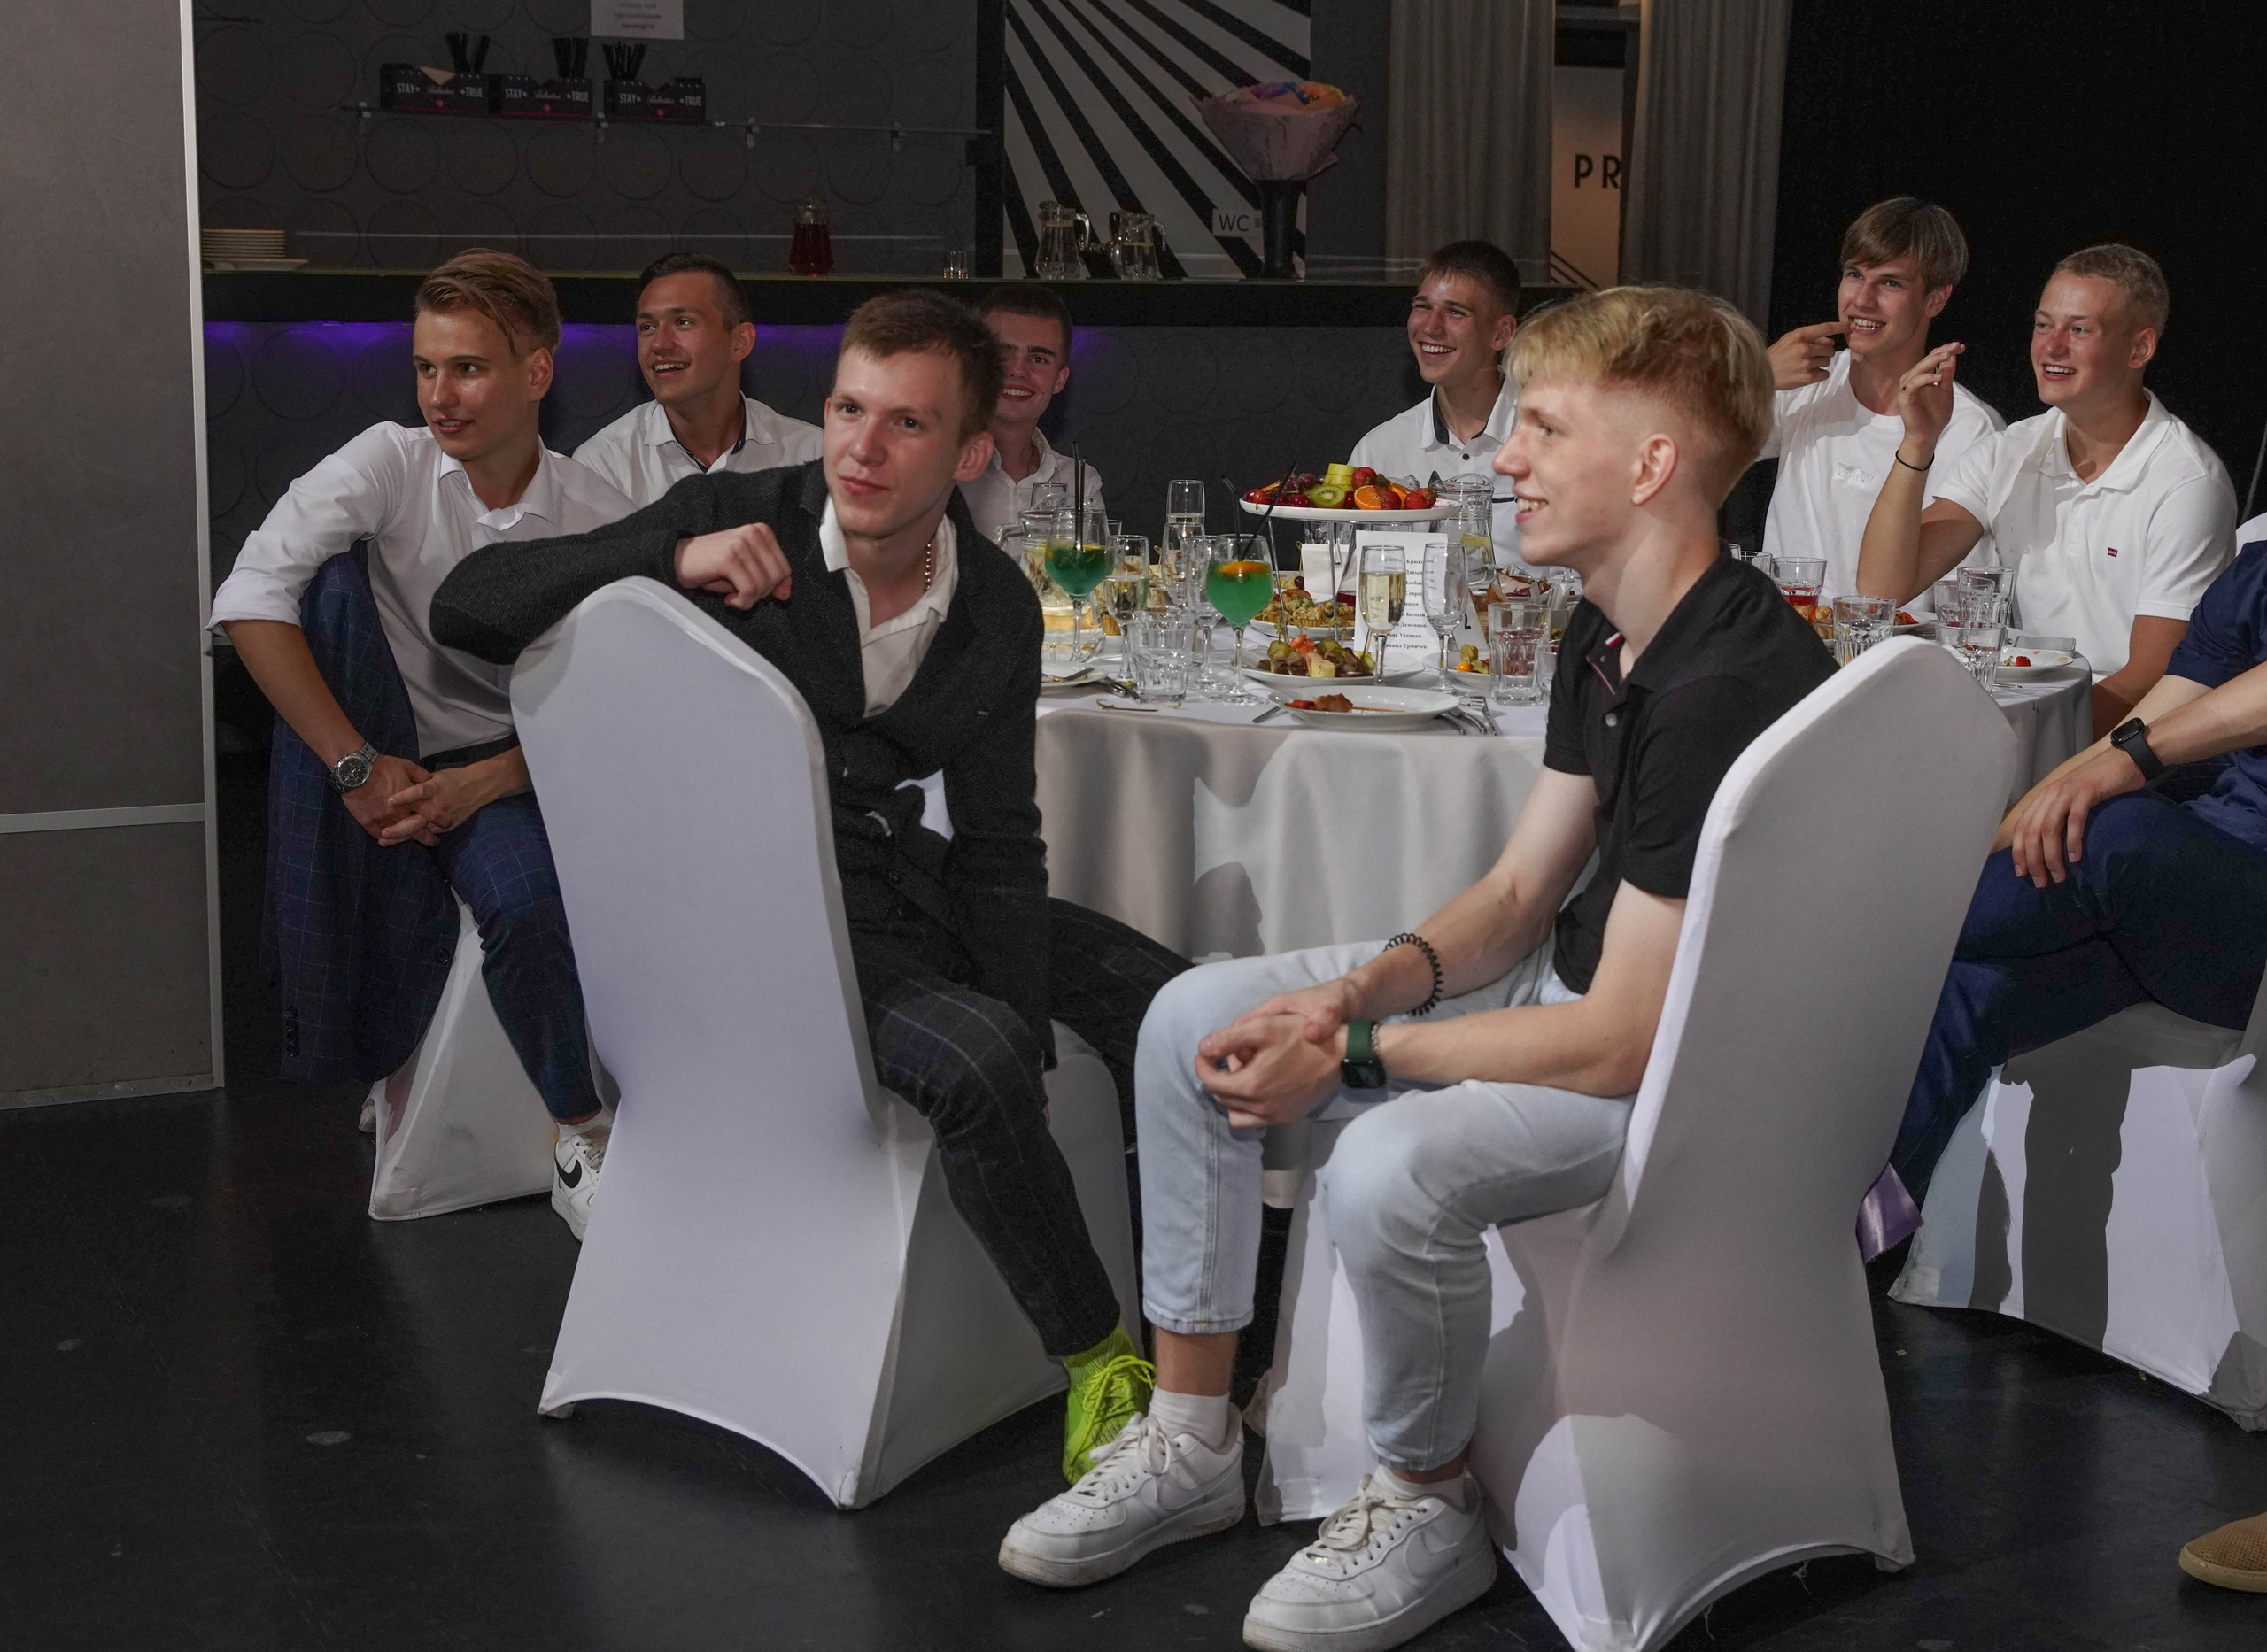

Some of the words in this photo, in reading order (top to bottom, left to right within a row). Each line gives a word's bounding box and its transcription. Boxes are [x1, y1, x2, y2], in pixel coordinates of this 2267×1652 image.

[396, 82, 415, 95] STAY
[465, 86, 484, 98] TRUE
[505, 88, 522, 99] STAY
[571, 91, 589, 103] TRUE
[619, 93, 637, 104] STAY
[685, 95, 702, 107] TRUE
[1219, 213, 1250, 232] WC
